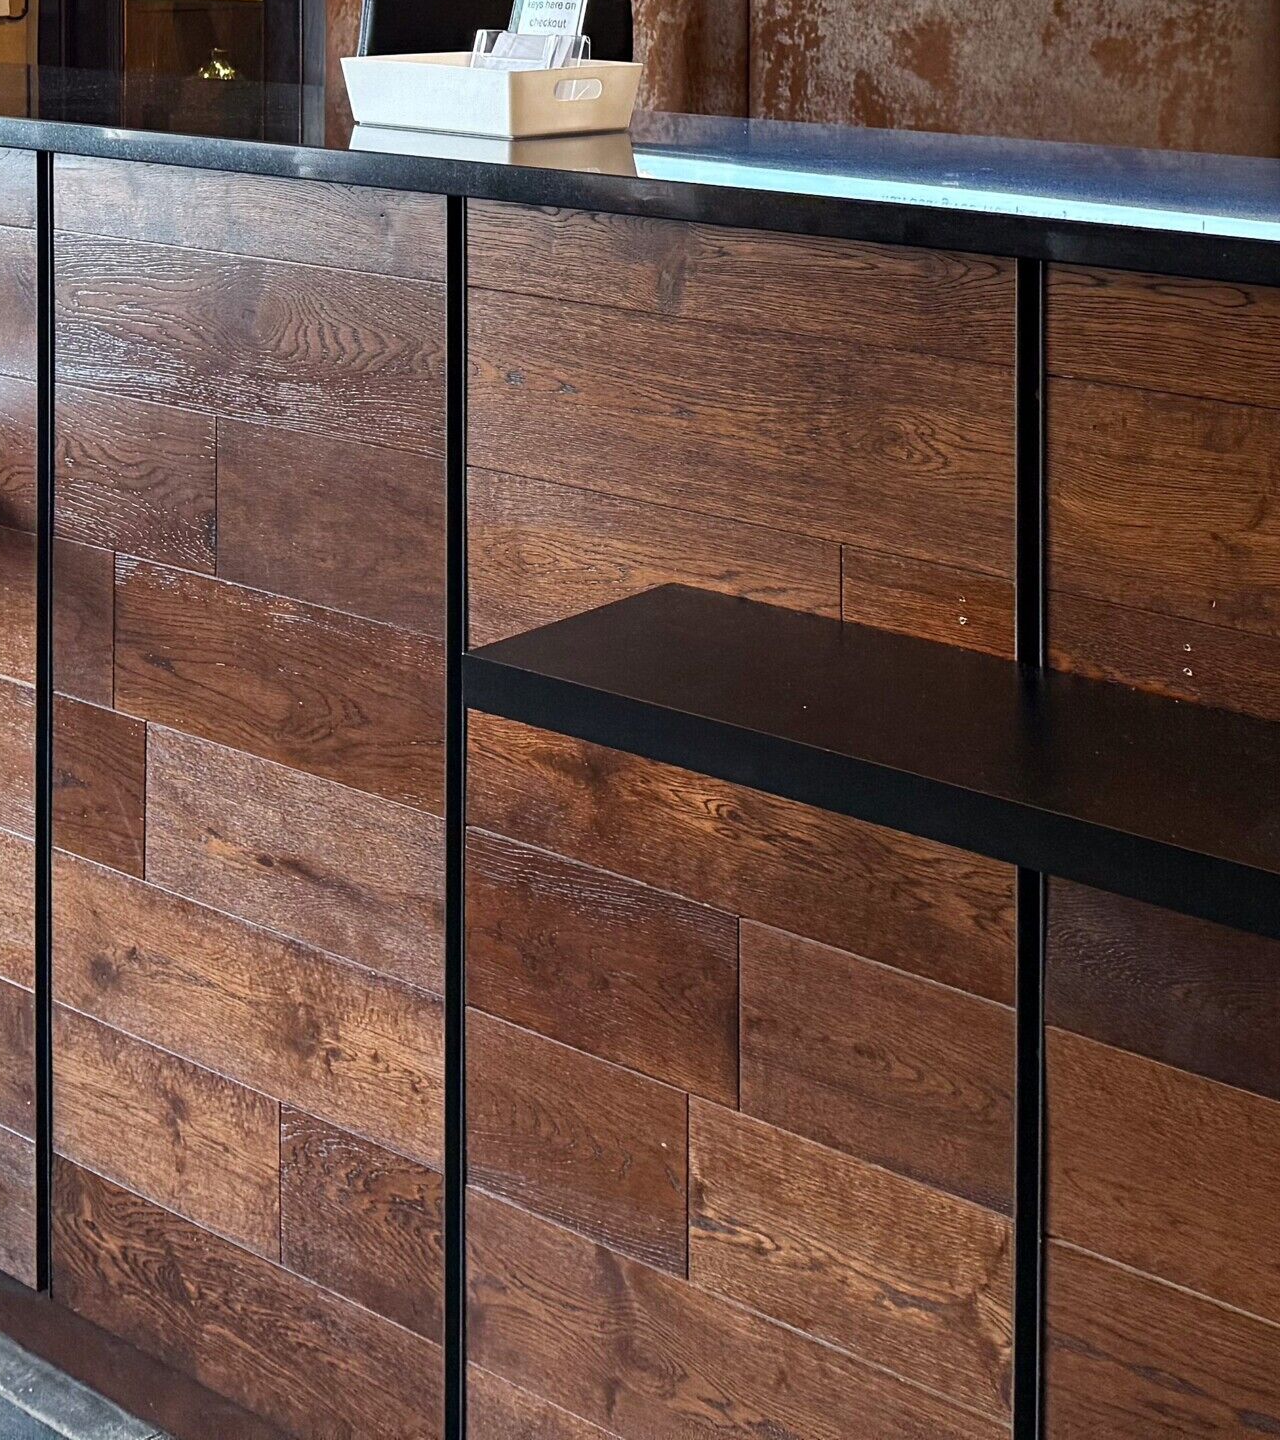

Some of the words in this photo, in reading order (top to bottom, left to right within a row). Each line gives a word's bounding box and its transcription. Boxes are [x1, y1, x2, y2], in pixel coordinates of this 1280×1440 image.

[528, 0, 543, 11] keys
[546, 1, 563, 9] here
[565, 2, 576, 10] on
[530, 17, 566, 28] checkout
